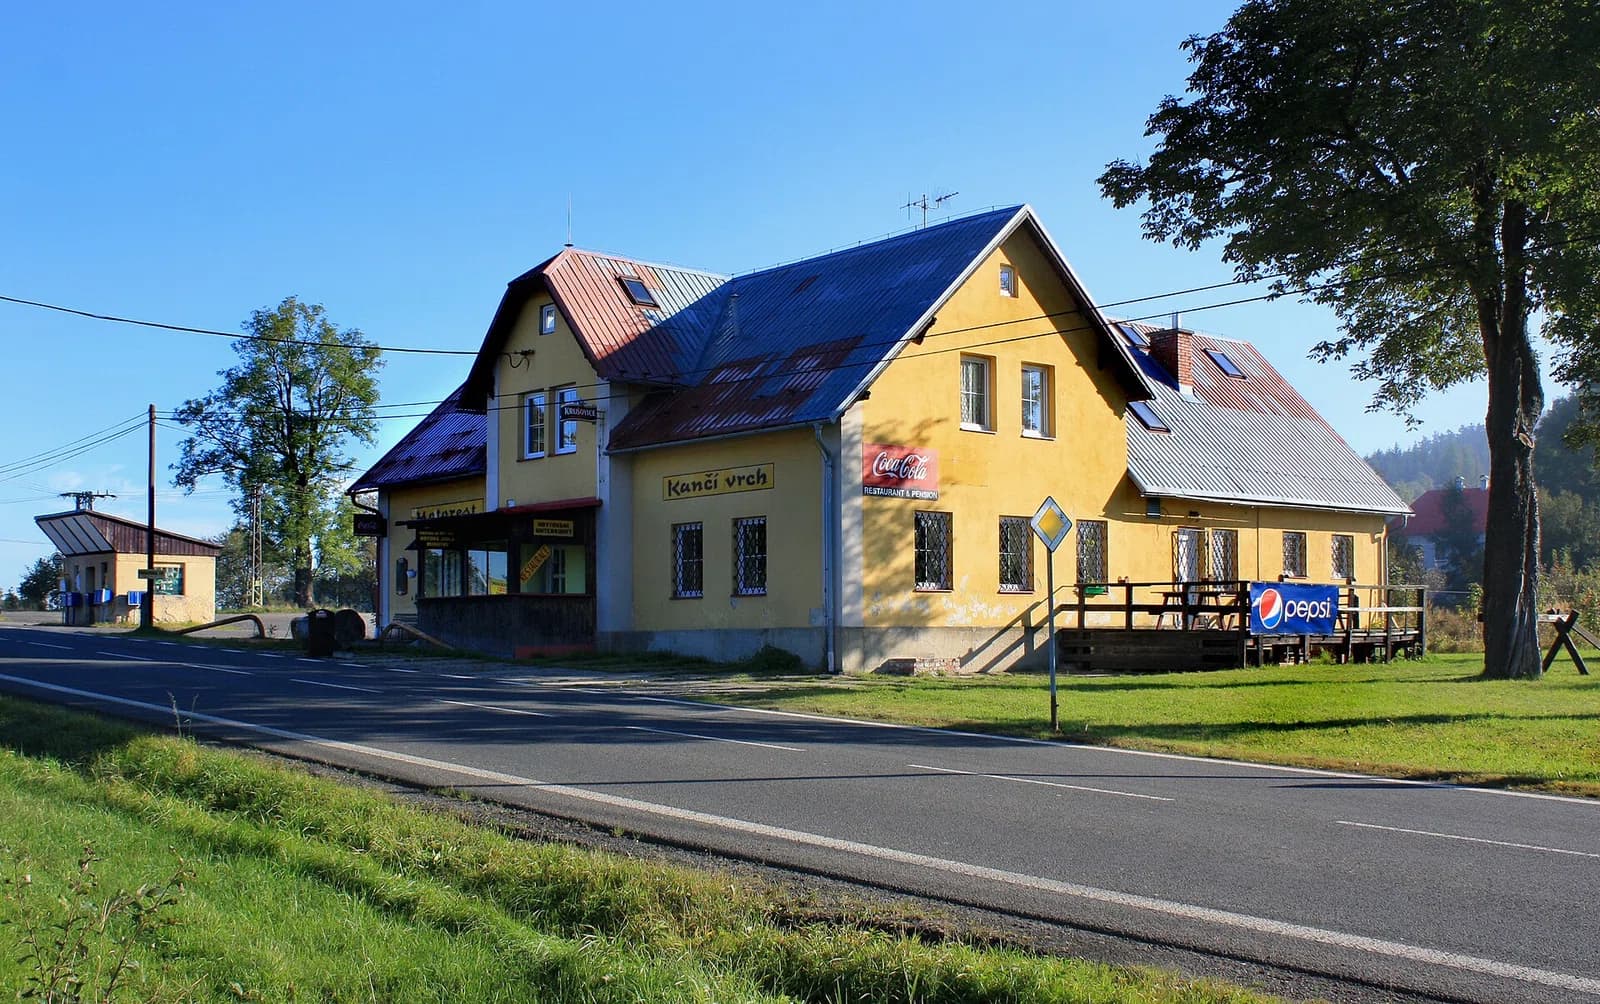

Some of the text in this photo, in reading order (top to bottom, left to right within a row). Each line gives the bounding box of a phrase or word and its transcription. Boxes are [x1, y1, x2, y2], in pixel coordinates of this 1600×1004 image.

[872, 451, 930, 481] Coca-Cola
[668, 468, 768, 497] Kančí vrch
[864, 486, 938, 500] RESTAURANT & PENSION
[1285, 597, 1331, 623] pepsi
